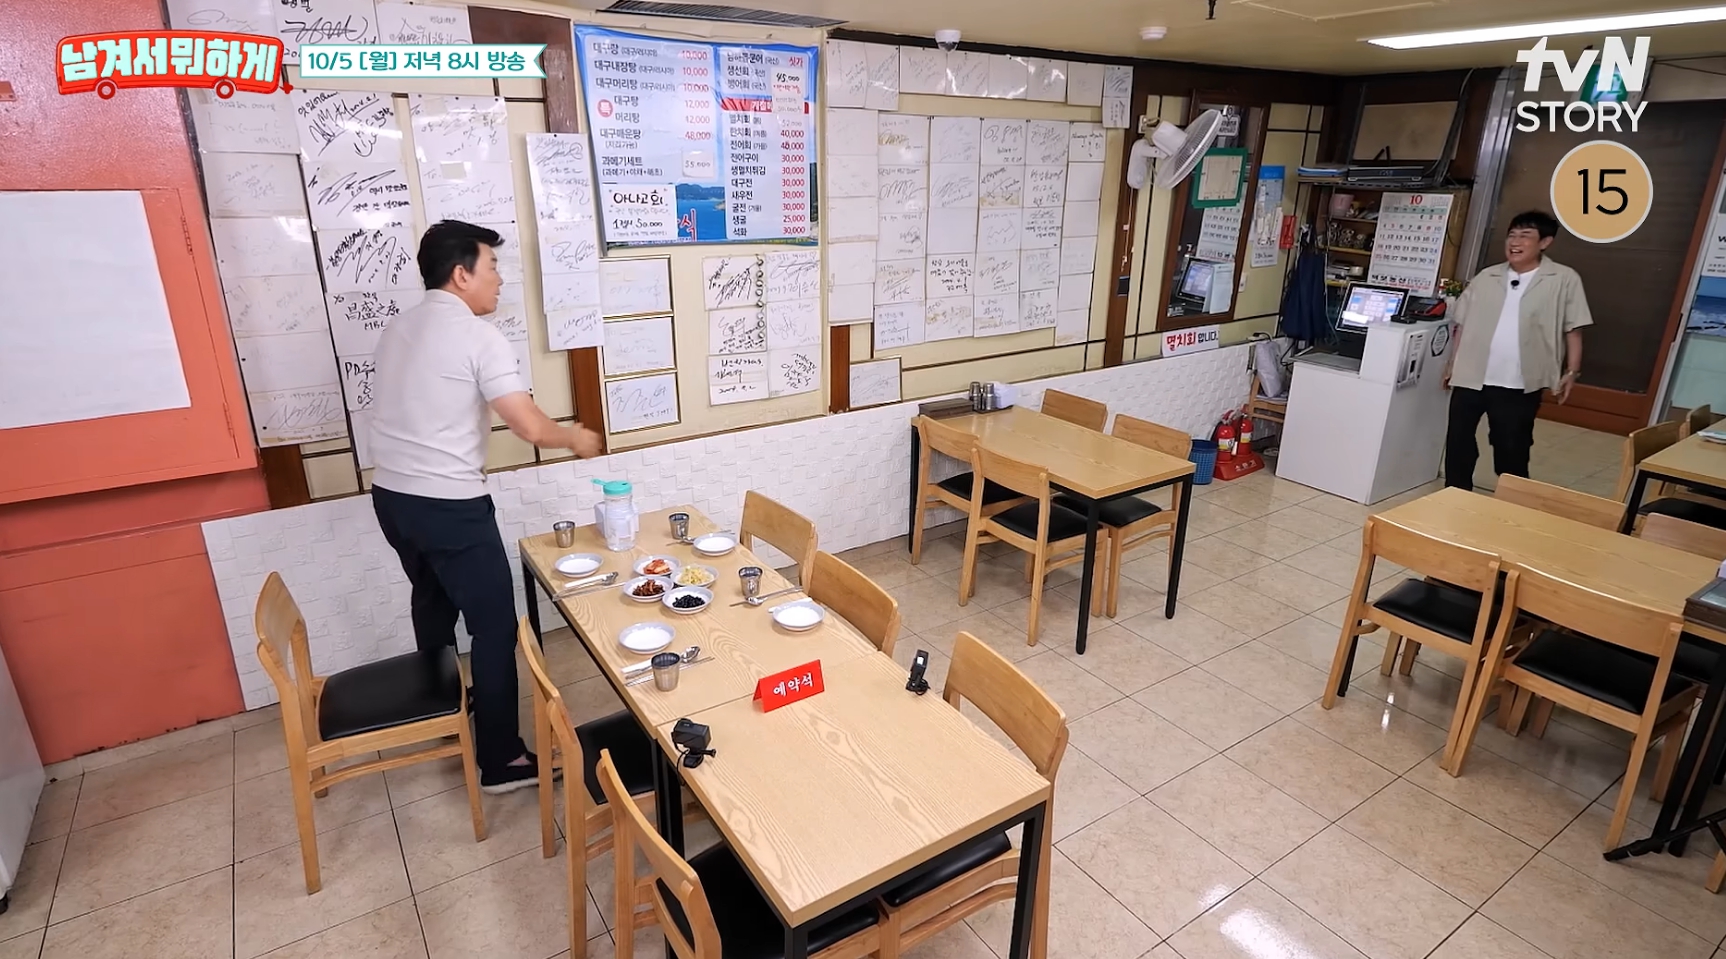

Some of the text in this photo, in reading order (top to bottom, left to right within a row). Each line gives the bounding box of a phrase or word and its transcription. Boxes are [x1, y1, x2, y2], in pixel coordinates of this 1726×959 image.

[682, 50, 708, 60] 10,000
[789, 56, 803, 67] 싯가
[594, 60, 637, 73] 대구내장탕
[682, 66, 708, 76] 10,000
[727, 65, 749, 76] 생선회
[595, 77, 638, 90] 대구머리탕
[683, 83, 709, 92] 10,000
[728, 79, 750, 90] 방어회
[613, 96, 710, 109] 대구탕 12,000
[599, 100, 612, 117] 특
[615, 112, 710, 124] 머리탕 12,000
[600, 128, 711, 140] 대구매운탕 48,000
[780, 130, 804, 139] 40,000
[730, 140, 752, 151] 전어회
[602, 156, 643, 167] 과메기세트
[730, 153, 805, 163] 전어구이 30,000
[731, 165, 805, 176] 생멸치튀김 30,000
[731, 178, 805, 188] 대구전 30,000
[731, 190, 805, 200] 새우전 30,000
[1410, 194, 1423, 205] 10
[732, 203, 746, 213] 굴전
[782, 203, 805, 211] 30,000
[732, 215, 805, 225] 생굴 25,000
[733, 227, 805, 237] 석화 30,000
[1166, 331, 1196, 351] 멸치회
[773, 672, 813, 697] 예약석
